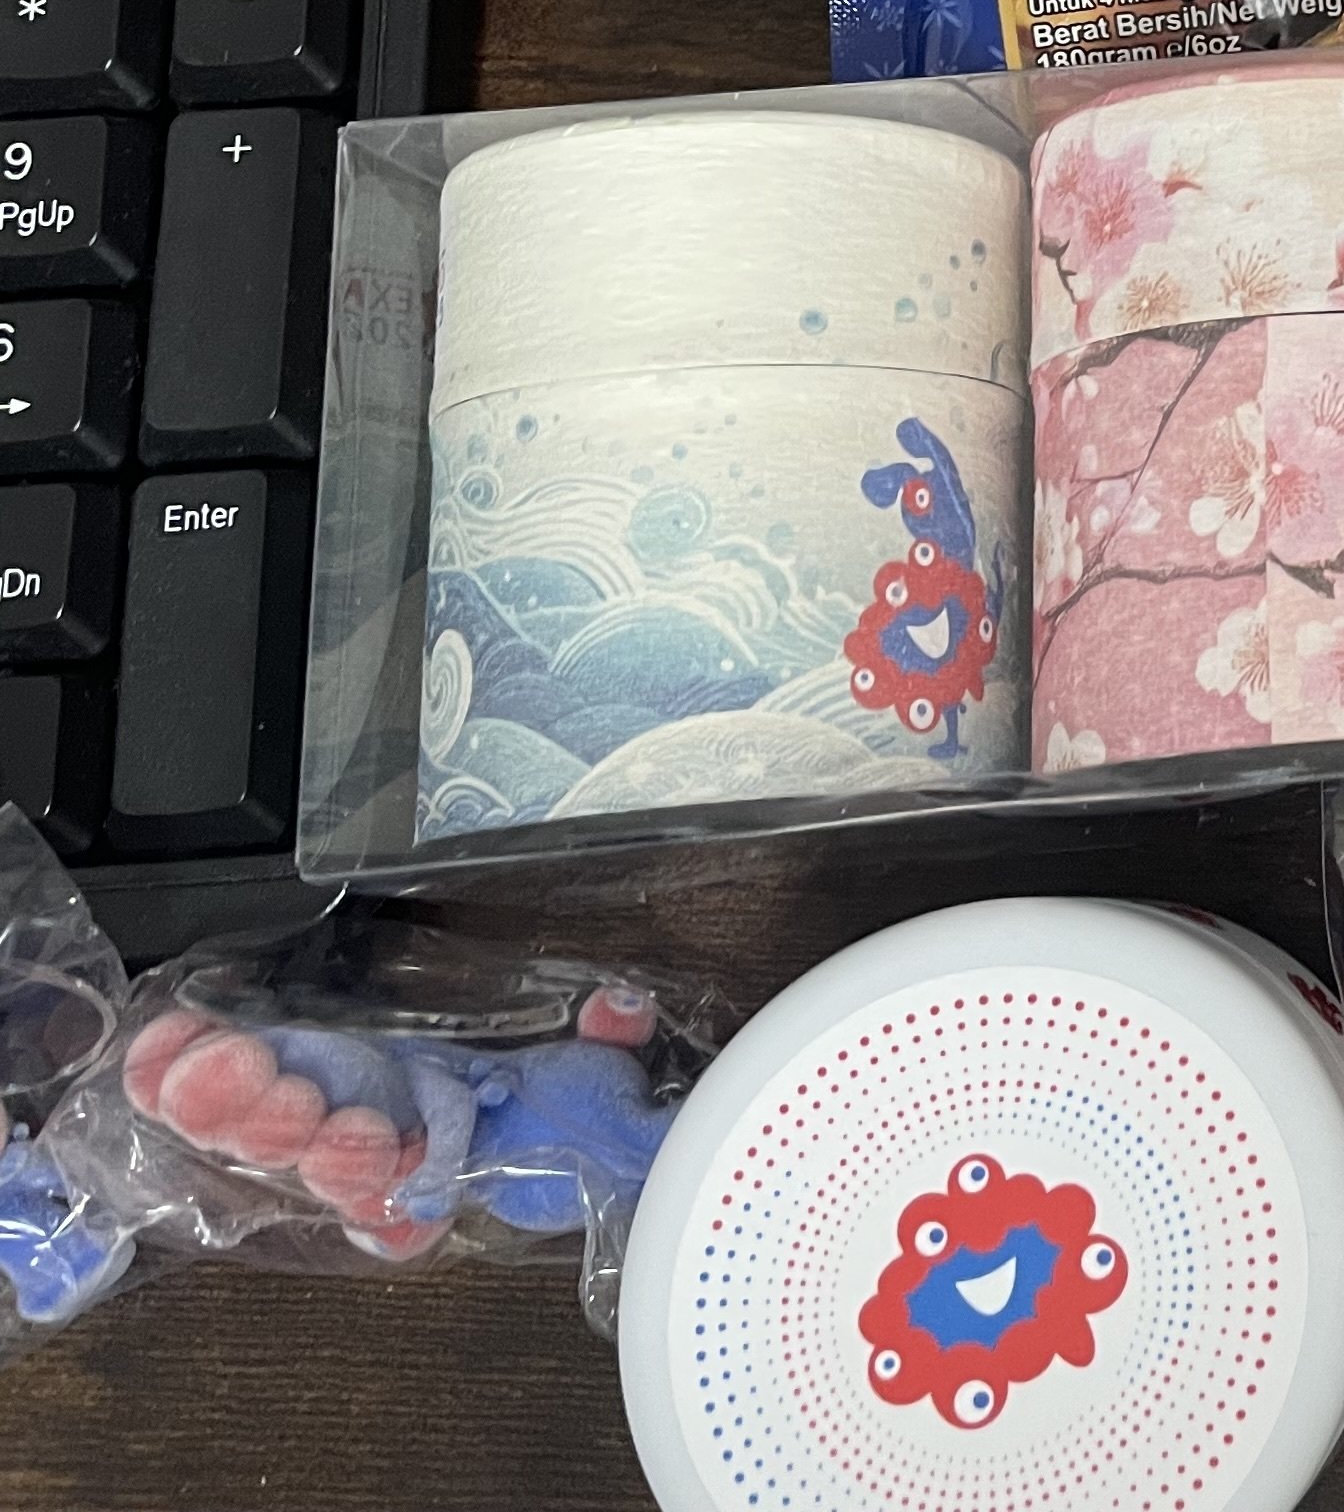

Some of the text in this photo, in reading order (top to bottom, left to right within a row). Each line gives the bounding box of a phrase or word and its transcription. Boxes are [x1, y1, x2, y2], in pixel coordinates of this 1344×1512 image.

[1032, 21, 1110, 49] Berat
[3, 142, 34, 182] 9
[162, 502, 240, 535] Enter
